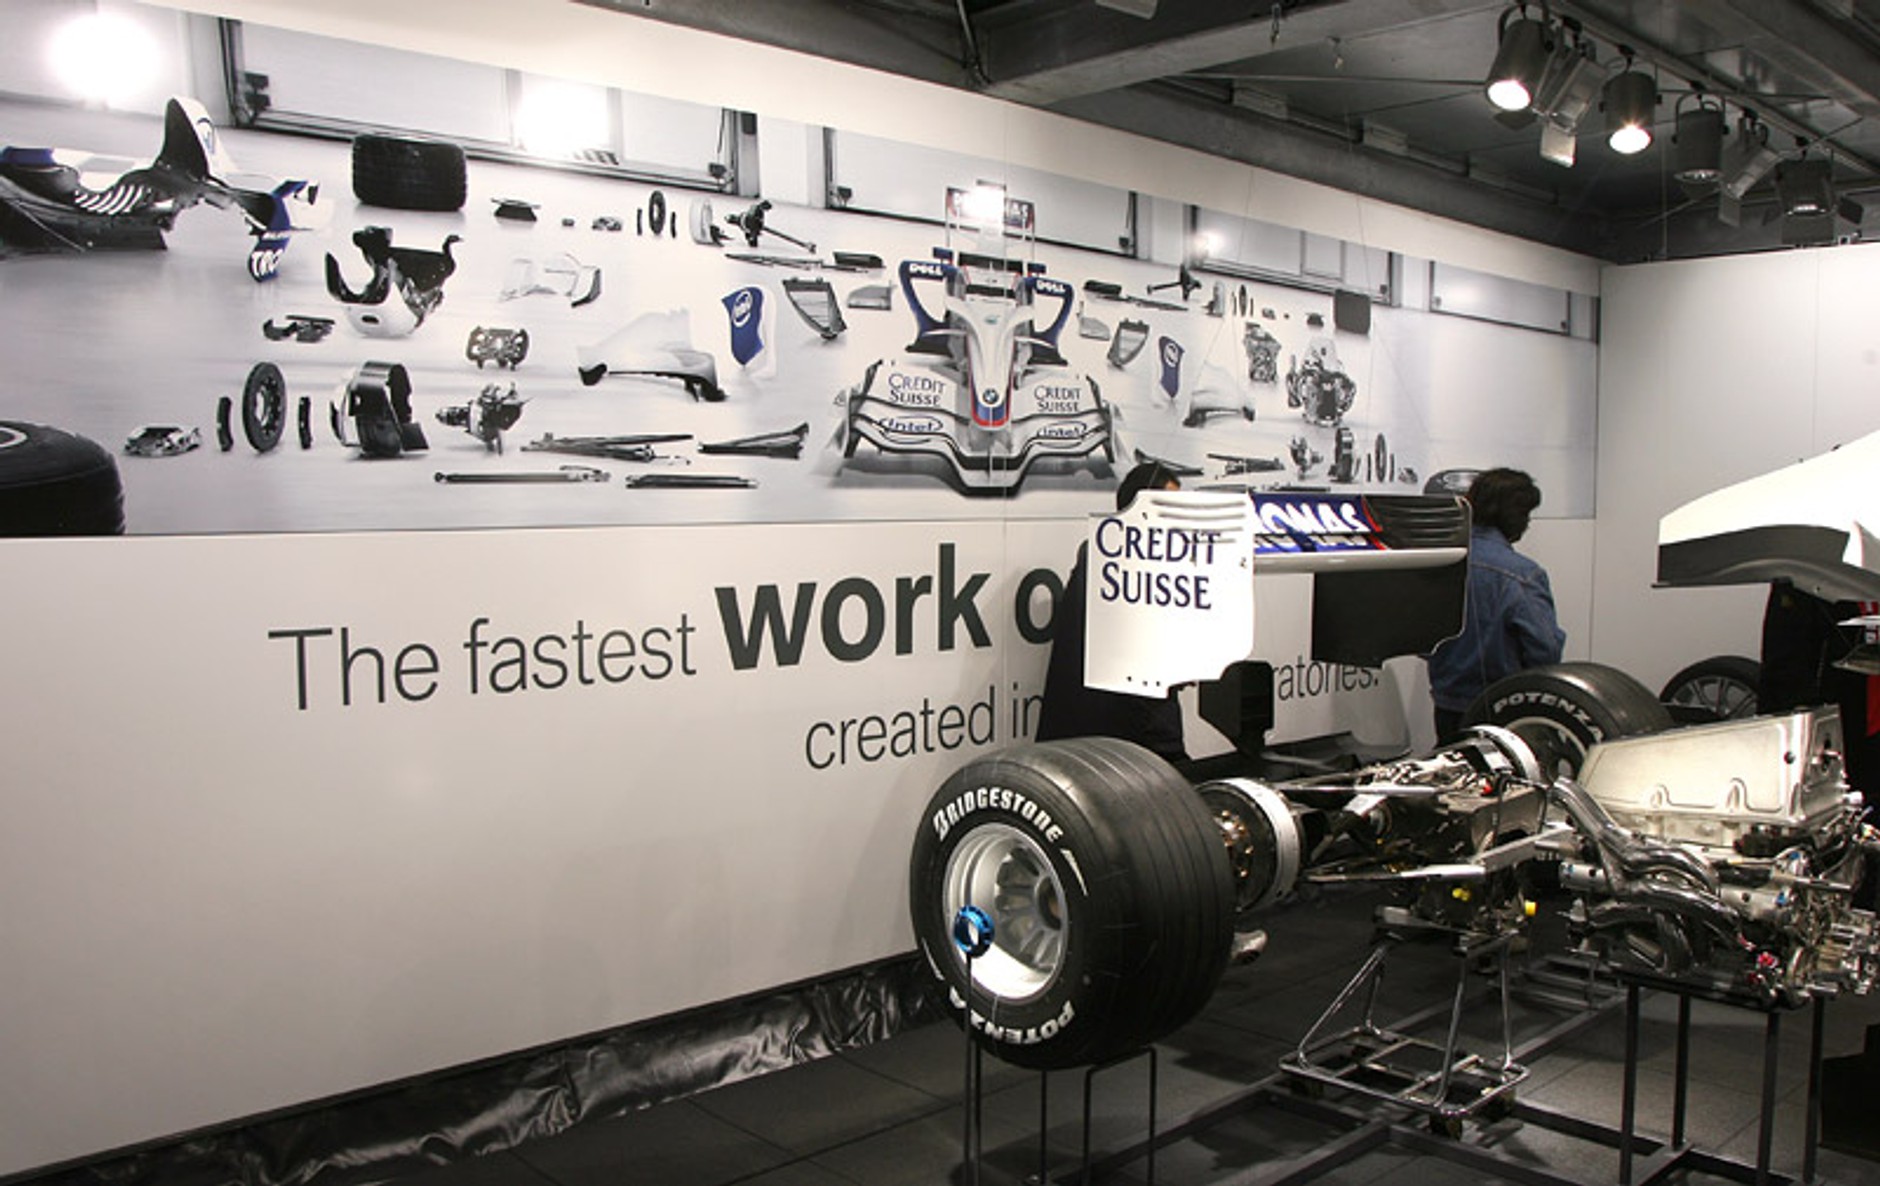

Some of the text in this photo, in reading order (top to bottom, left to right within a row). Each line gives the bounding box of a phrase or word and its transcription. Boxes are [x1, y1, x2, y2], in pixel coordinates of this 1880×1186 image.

[888, 373, 947, 393] CREDIT
[890, 389, 941, 407] SUISSE
[1034, 385, 1082, 400] CREDIT
[1037, 400, 1080, 412] SUISSE
[1096, 518, 1221, 565] CREDIT
[1100, 562, 1211, 610] SUISSE
[268, 542, 1064, 711] The fastest work o
[806, 684, 995, 769] created
[1493, 692, 1605, 743] POTENZA
[933, 787, 1064, 842] BRIDGESTONE
